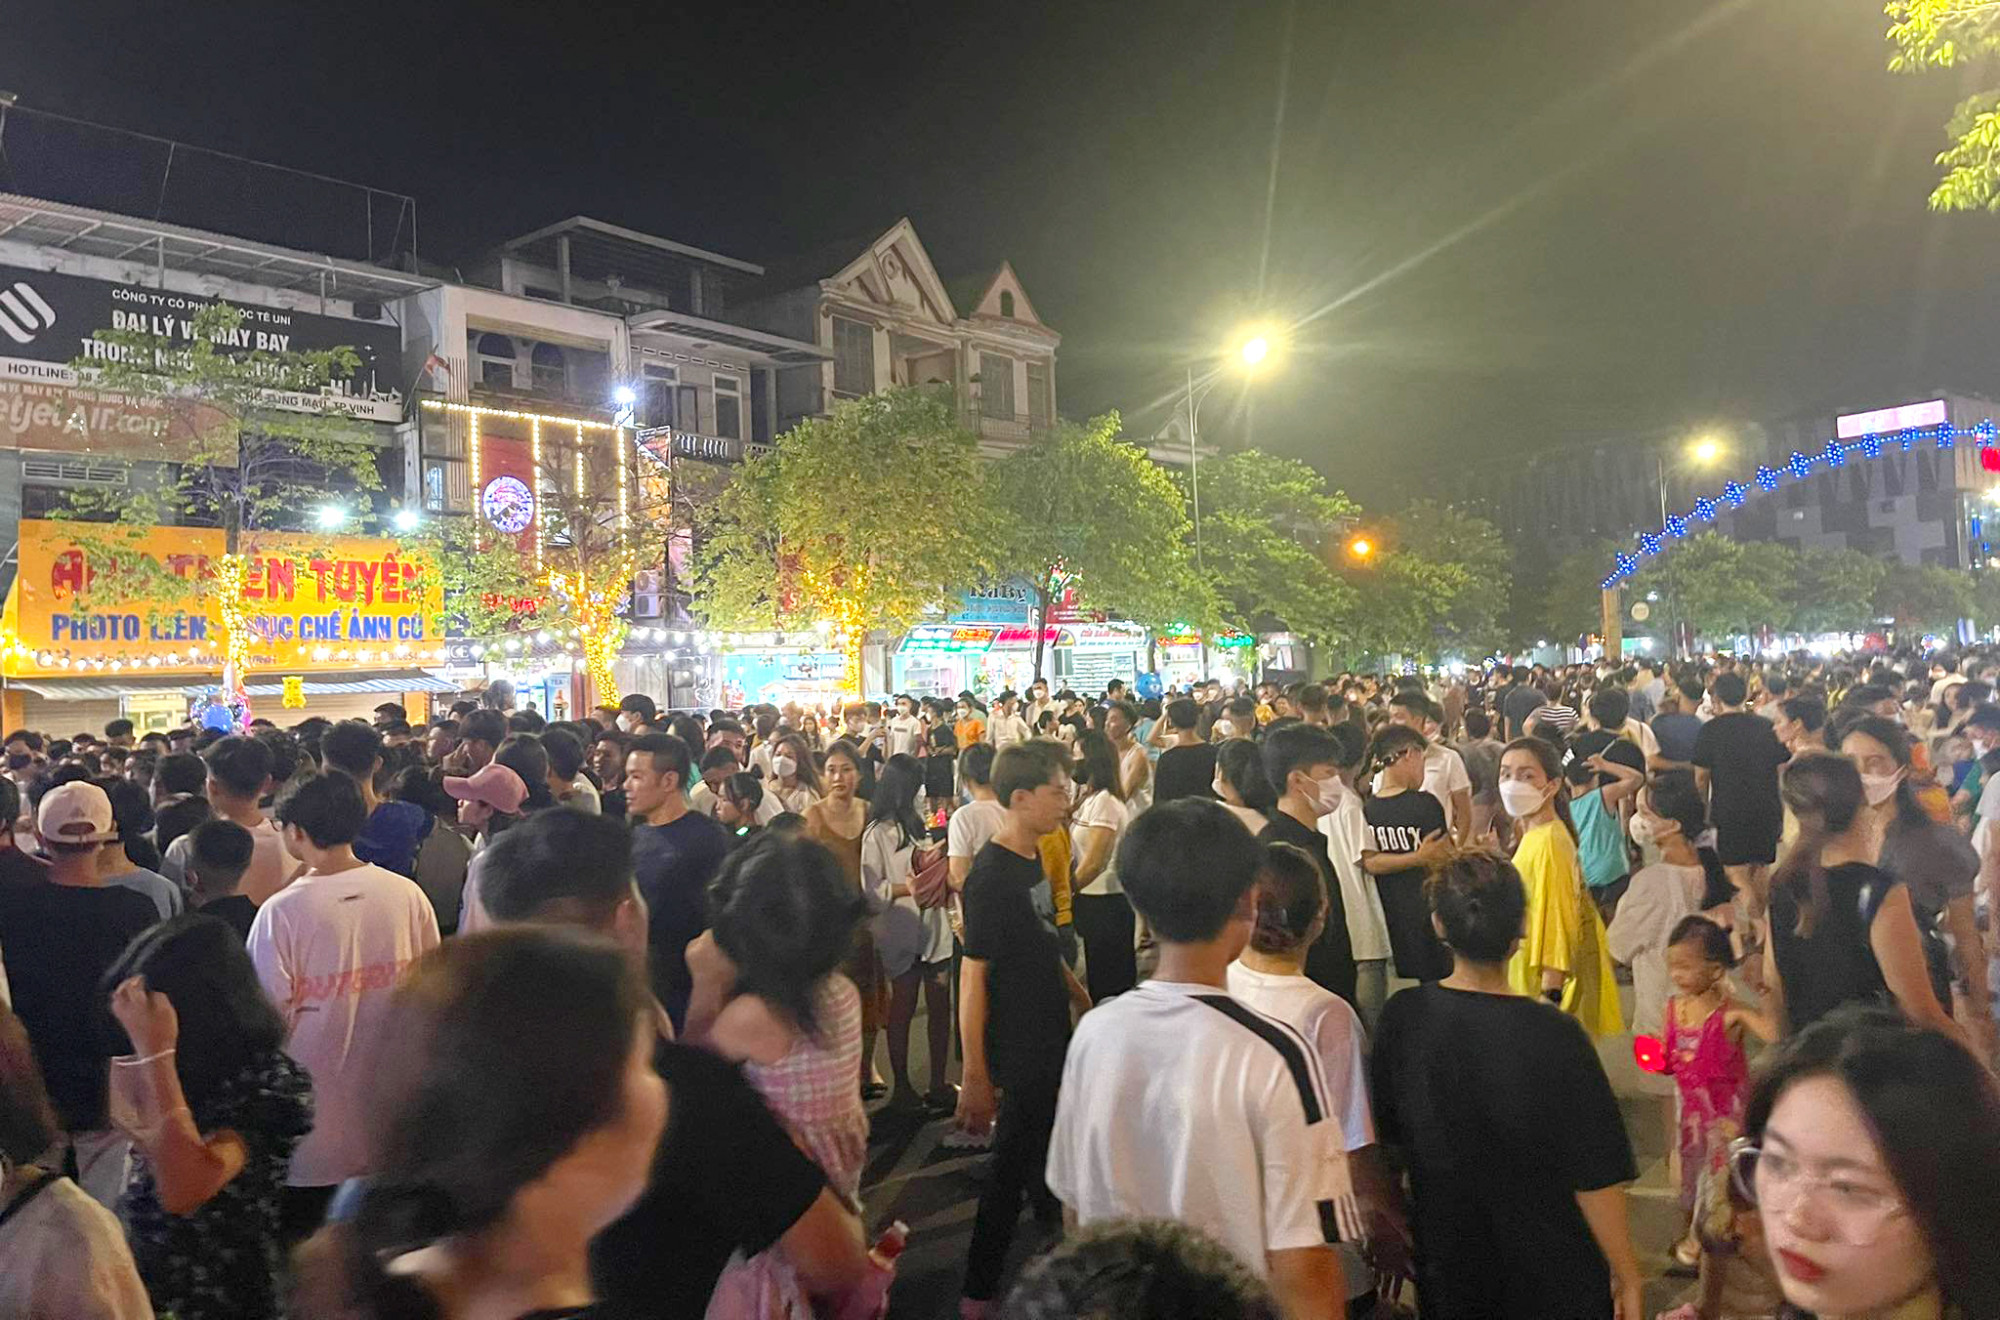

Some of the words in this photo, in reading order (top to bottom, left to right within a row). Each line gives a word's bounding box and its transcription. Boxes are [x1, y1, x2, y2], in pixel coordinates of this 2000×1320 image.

[112, 288, 148, 304] CÔNG
[150, 295, 165, 306] TY
[272, 314, 291, 326] UNI
[152, 314, 175, 337] LÝ
[256, 331, 290, 352] BAY
[8, 363, 74, 380] HOTLINE:
[349, 404, 375, 415] VINH
[52, 613, 140, 641] PHOTO
